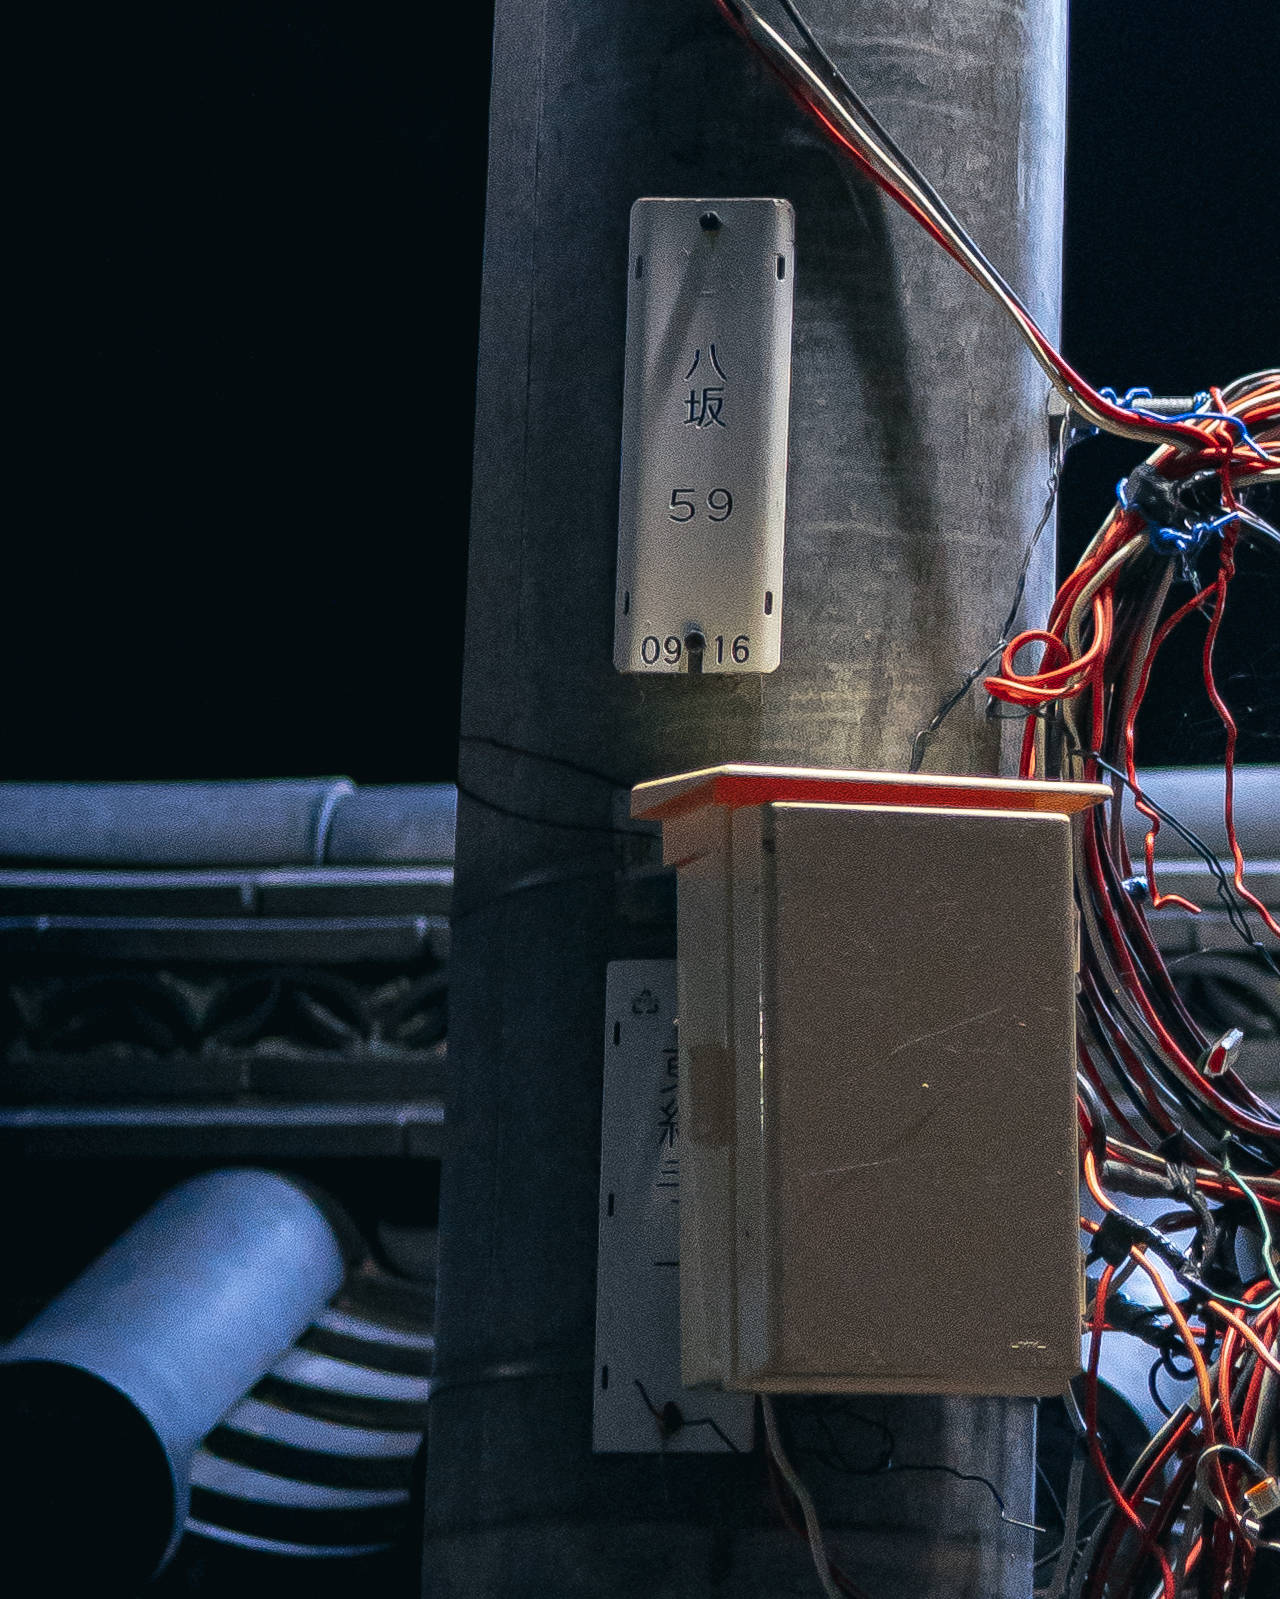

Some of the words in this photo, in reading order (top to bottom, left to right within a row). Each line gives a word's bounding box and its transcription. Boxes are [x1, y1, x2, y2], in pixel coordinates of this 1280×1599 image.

[683, 343, 728, 429] 八坂
[668, 486, 734, 524] 59
[640, 634, 683, 666] 09
[713, 633, 751, 665] 16
